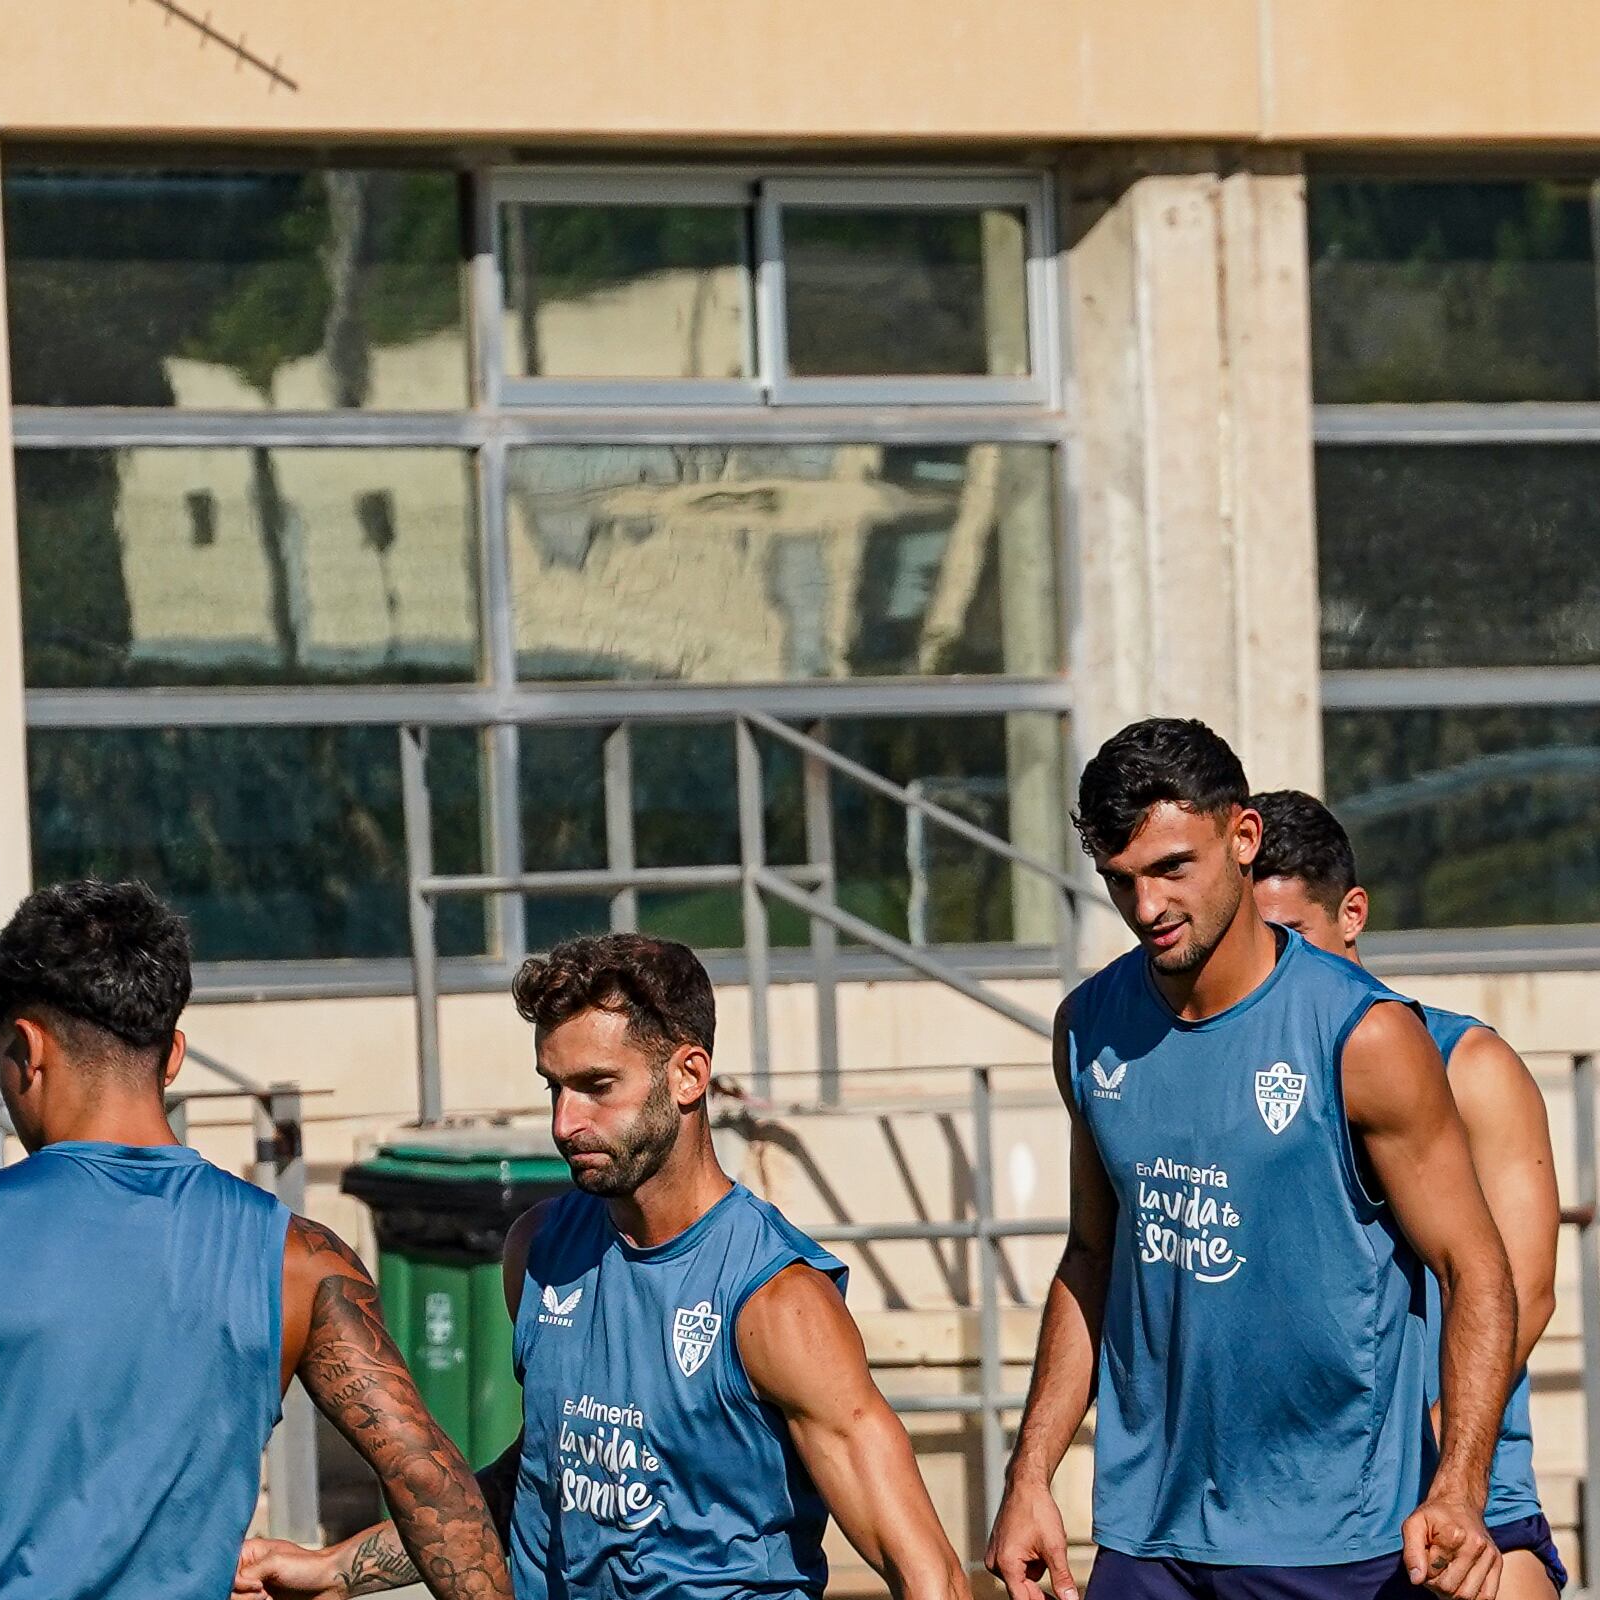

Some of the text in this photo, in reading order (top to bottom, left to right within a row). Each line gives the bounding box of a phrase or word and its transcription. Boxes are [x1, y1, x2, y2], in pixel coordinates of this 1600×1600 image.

[1136, 1156, 1229, 1189] En Almería
[1138, 1182, 1241, 1230] la vida te
[576, 1394, 644, 1430] Almería
[559, 1420, 660, 1474] la vida te
